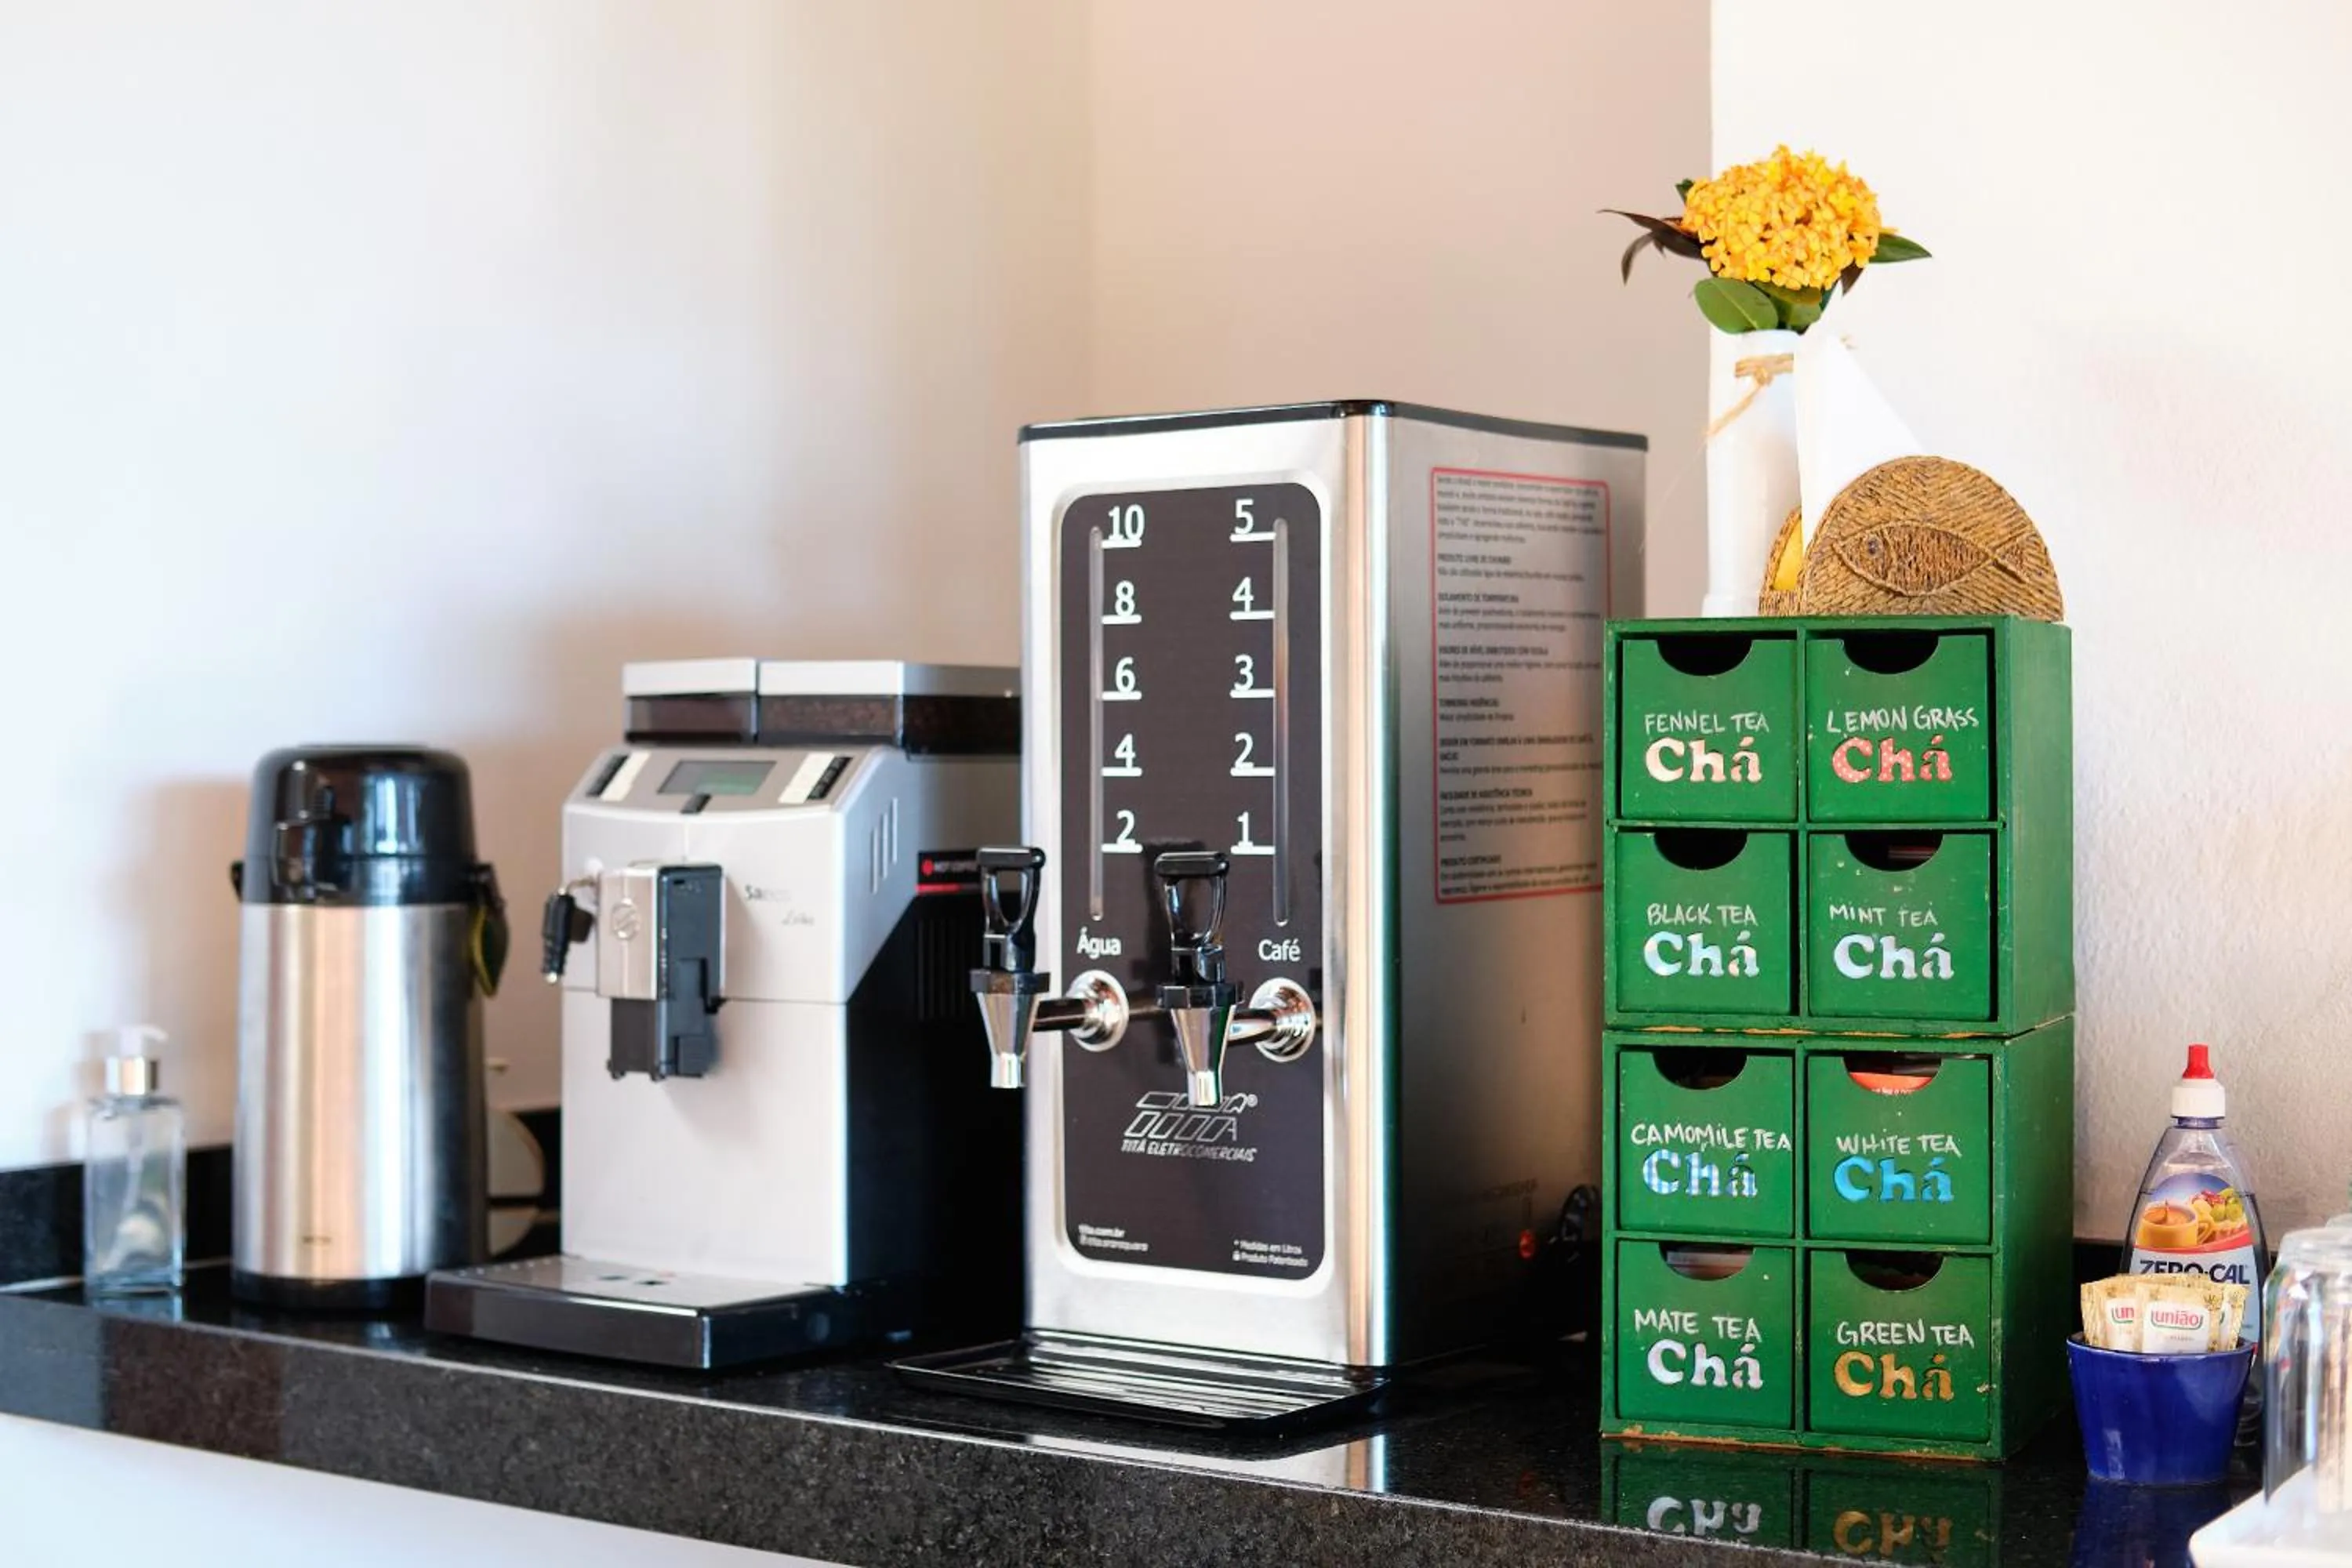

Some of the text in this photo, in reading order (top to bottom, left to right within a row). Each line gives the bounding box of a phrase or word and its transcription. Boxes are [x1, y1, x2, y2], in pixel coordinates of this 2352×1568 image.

[1108, 504, 1145, 540] 10
[1235, 499, 1254, 534] 5
[1115, 580, 1135, 616] 8
[1232, 577, 1254, 612] 4
[1116, 657, 1136, 692] 6
[1234, 655, 1254, 691] 3
[1645, 710, 1769, 735] FENNEL TEA
[1828, 705, 1979, 734] LEMON GRASS
[1114, 733, 1136, 768] 4
[1235, 732, 1254, 768] 2
[1644, 736, 1762, 783] Chá
[1831, 734, 1953, 783] Chá
[1116, 810, 1136, 844] 2
[1237, 811, 1254, 847] 1
[1647, 902, 1758, 926] BLACK TEA
[1829, 904, 1938, 927] MINT TEA
[1076, 927, 1122, 960] Água
[1258, 938, 1301, 963] Café
[1643, 931, 1760, 978] Chá
[1833, 932, 1955, 980] Chá
[1631, 1122, 1792, 1152] CAMOMILE TEA
[1836, 1132, 1962, 1157] WHITE TEA
[1642, 1149, 1759, 1198] Chá
[1834, 1156, 1955, 1203] Chá
[1635, 1308, 1761, 1343] MATE TEA
[1837, 1318, 1974, 1347] GREEN TEA
[2156, 1308, 2199, 1326] união
[1647, 1340, 1764, 1388] Chá
[1835, 1351, 1955, 1400] Chá
